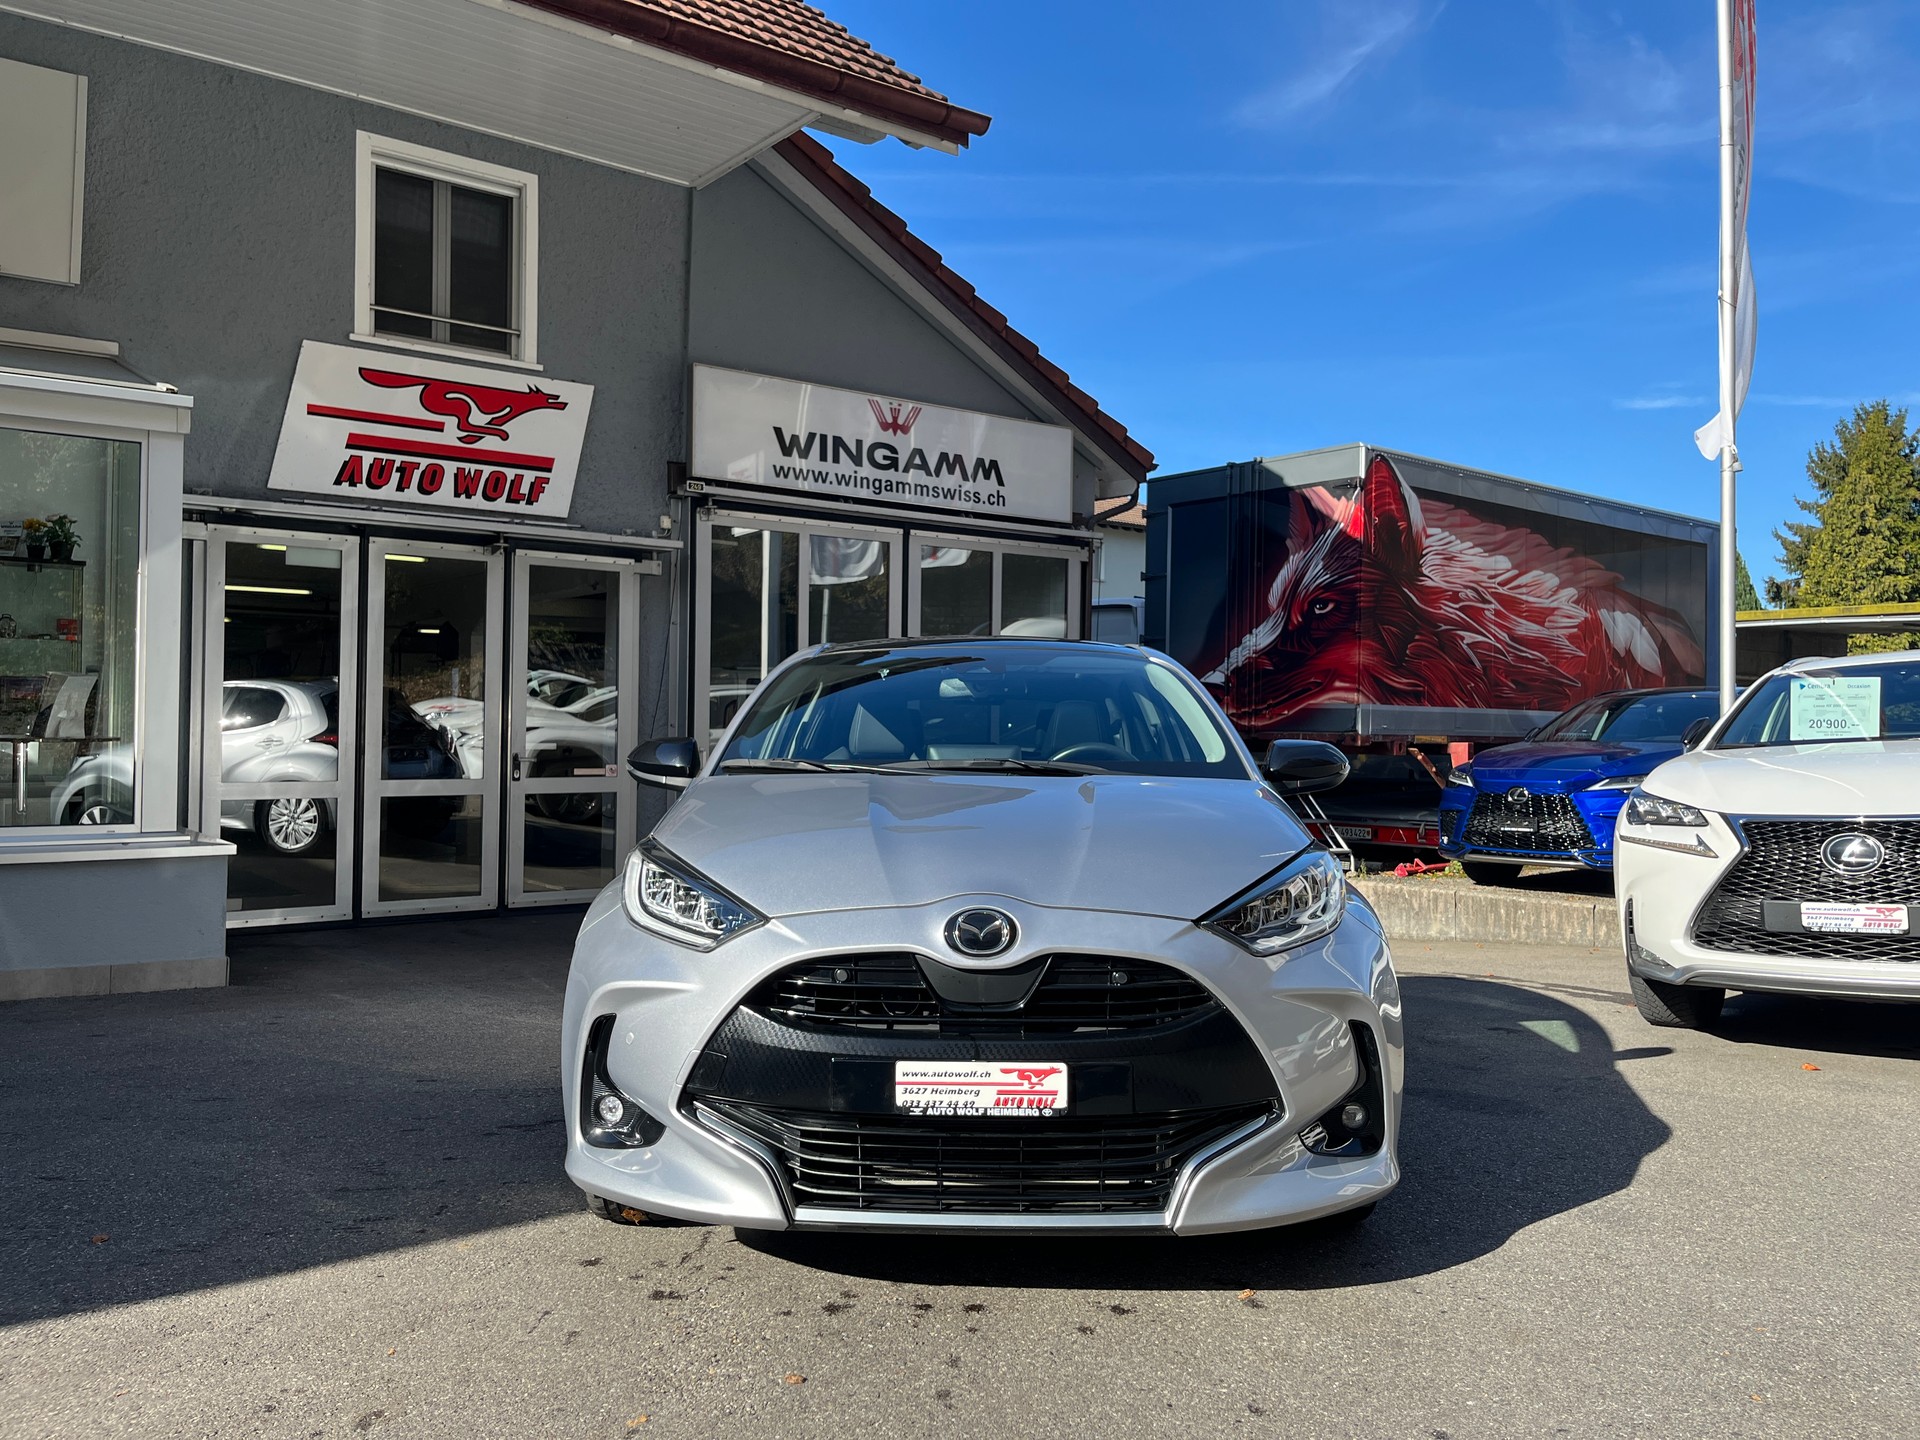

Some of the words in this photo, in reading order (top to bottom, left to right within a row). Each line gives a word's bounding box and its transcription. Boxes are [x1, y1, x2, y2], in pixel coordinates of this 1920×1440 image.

[772, 426, 1005, 487] WINGAMM
[333, 454, 445, 496] AUTO
[453, 466, 550, 506] WOLF
[772, 464, 1006, 507] www.wingammswiss.ch
[902, 1070, 991, 1078] www.autowolf.ch
[901, 1087, 928, 1095] 3627
[930, 1087, 981, 1097] Heimberg
[993, 1096, 1025, 1108] AUTO
[1027, 1096, 1057, 1108] WOLF
[926, 1107, 954, 1115] AUTO
[956, 1107, 984, 1116] WOLF
[986, 1108, 1040, 1116] HEIMBERG
